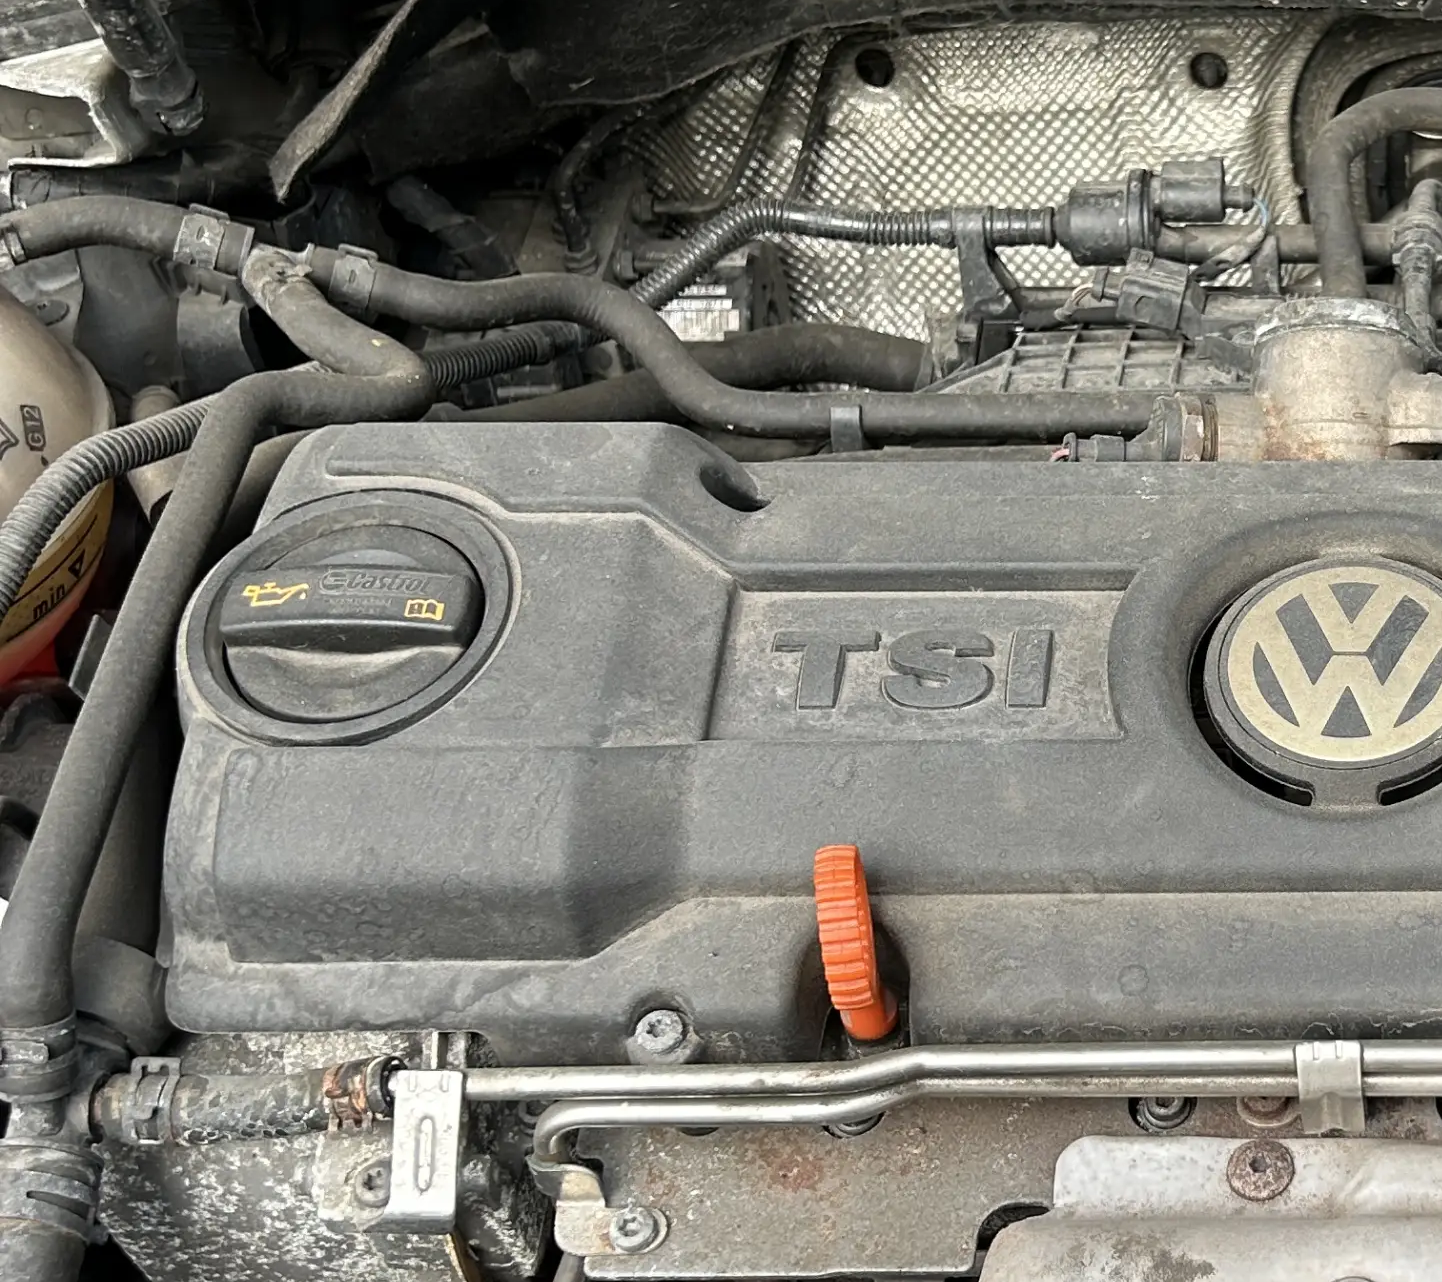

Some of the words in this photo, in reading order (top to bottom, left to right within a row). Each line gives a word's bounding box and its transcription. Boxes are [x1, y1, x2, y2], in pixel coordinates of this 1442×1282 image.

[33, 583, 65, 620] min
[346, 572, 430, 594] Castrol
[770, 629, 1055, 711] TSI
